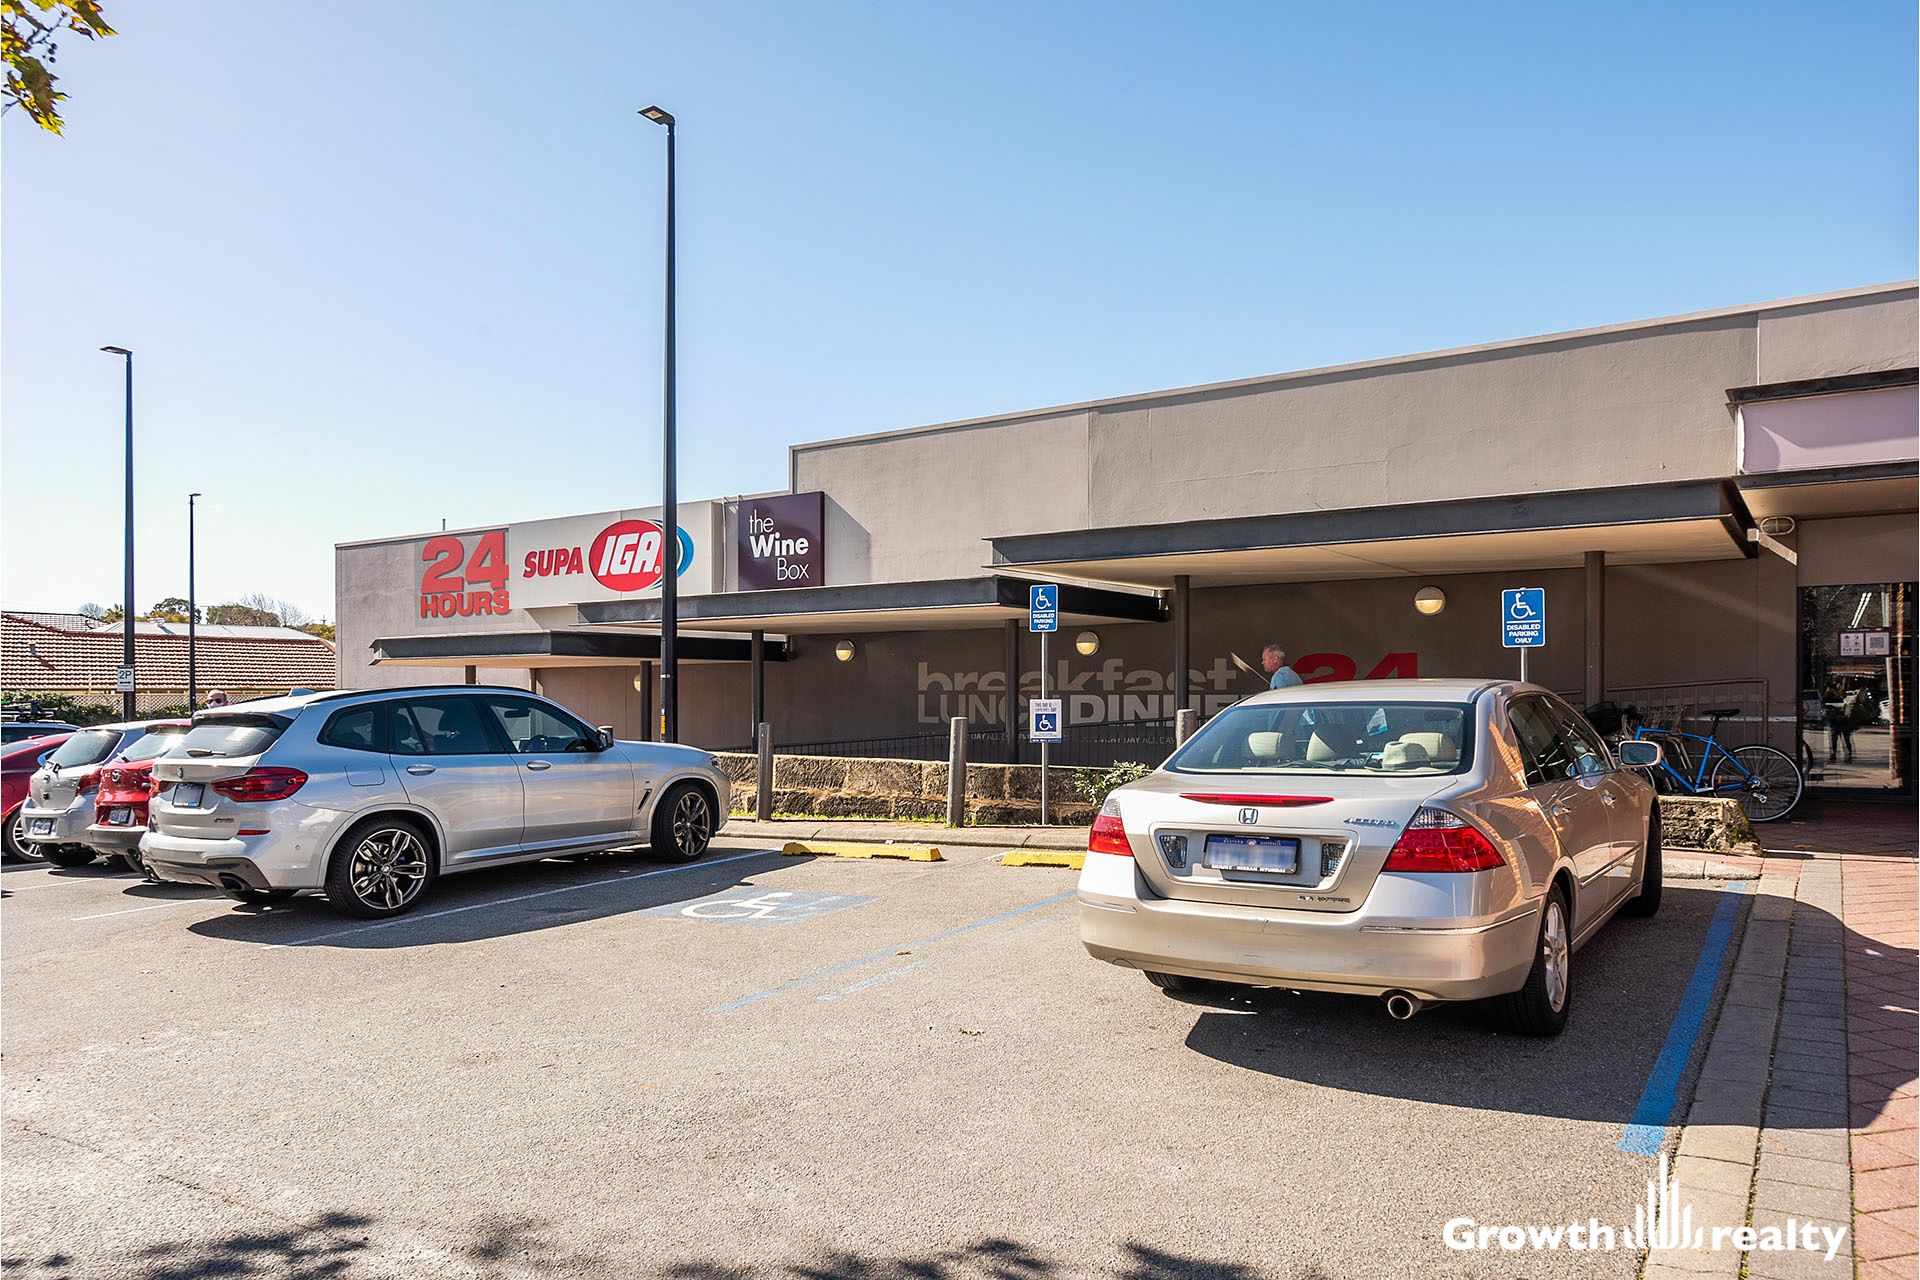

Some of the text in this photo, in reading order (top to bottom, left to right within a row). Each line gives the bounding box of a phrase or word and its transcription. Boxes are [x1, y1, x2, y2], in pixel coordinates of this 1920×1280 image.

[749, 508, 774, 533] the
[523, 531, 662, 578] SUPA IGA
[749, 531, 809, 558] Wine
[421, 531, 509, 594] 24
[777, 557, 810, 581] Box
[420, 590, 511, 618] HOURS
[1506, 623, 1541, 631] DISABLED
[119, 670, 132, 679] 2P
